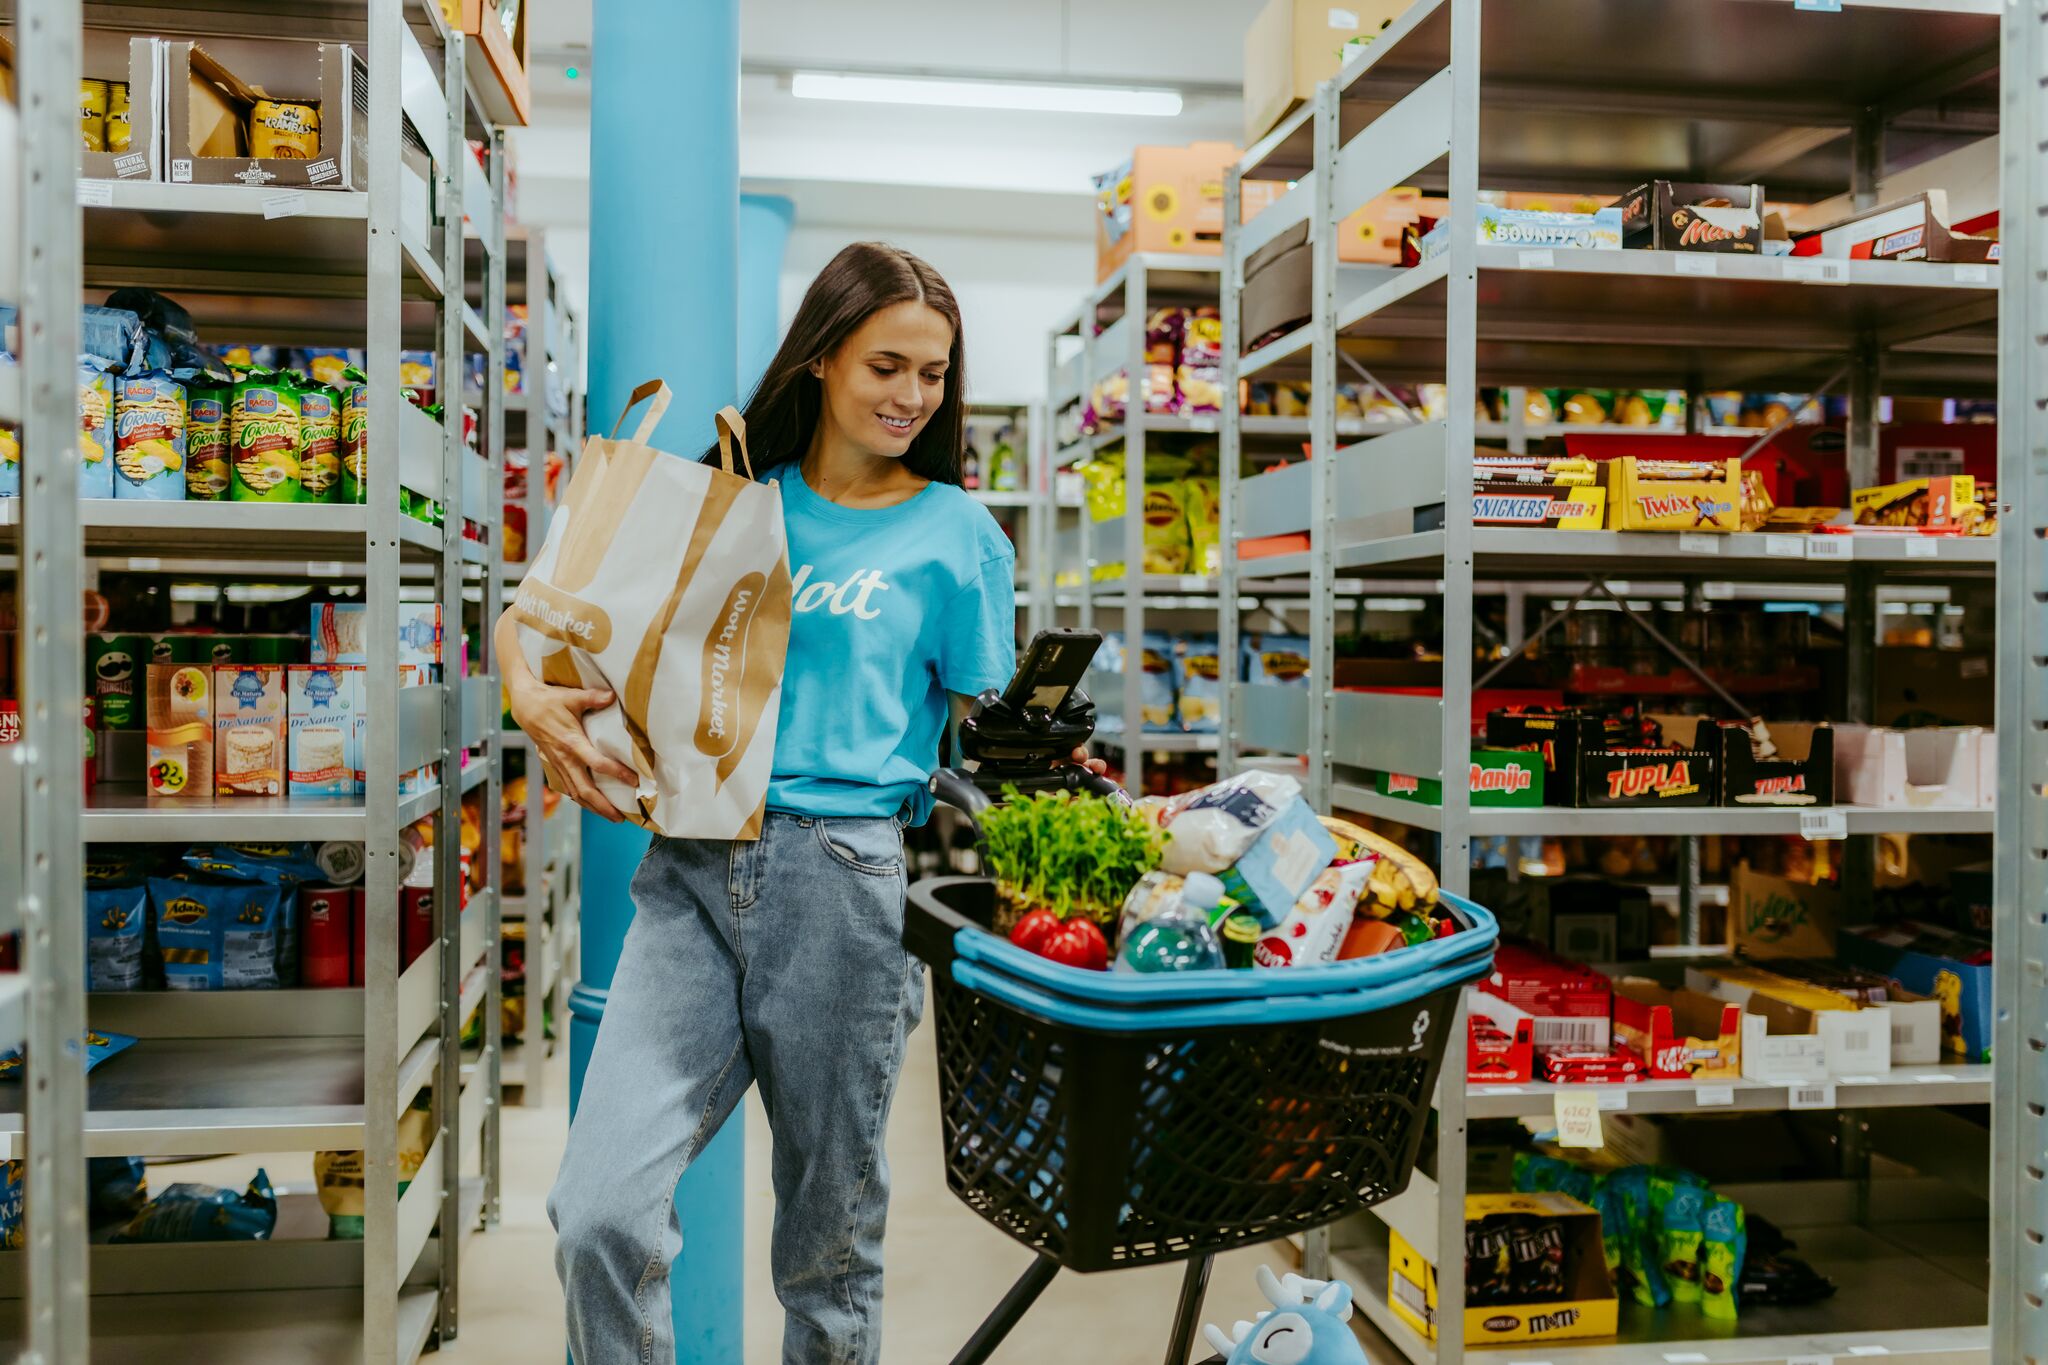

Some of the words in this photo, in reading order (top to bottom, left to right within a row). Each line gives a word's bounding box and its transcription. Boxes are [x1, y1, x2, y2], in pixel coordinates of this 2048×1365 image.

[114, 155, 146, 170] NATURAL
[174, 161, 190, 170] NEW
[306, 160, 337, 176] NATURAL
[1495, 225, 1572, 244] BOUNTY
[126, 386, 154, 397] RACIO
[246, 398, 274, 408] RACIO
[302, 403, 328, 412] RACIO
[117, 409, 168, 439] CORNIES
[187, 429, 231, 458] CORNIES
[239, 420, 288, 449] CORNIES
[301, 424, 340, 451] CORNIES
[1473, 498, 1547, 518] SNICKERS
[1549, 503, 1584, 516] SUPER
[537, 597, 596, 641] Market
[96, 679, 133, 695] PRINGLES
[707, 643, 731, 740] Market
[1607, 760, 1691, 799] TUPLA
[1755, 774, 1806, 796] TUPLA
